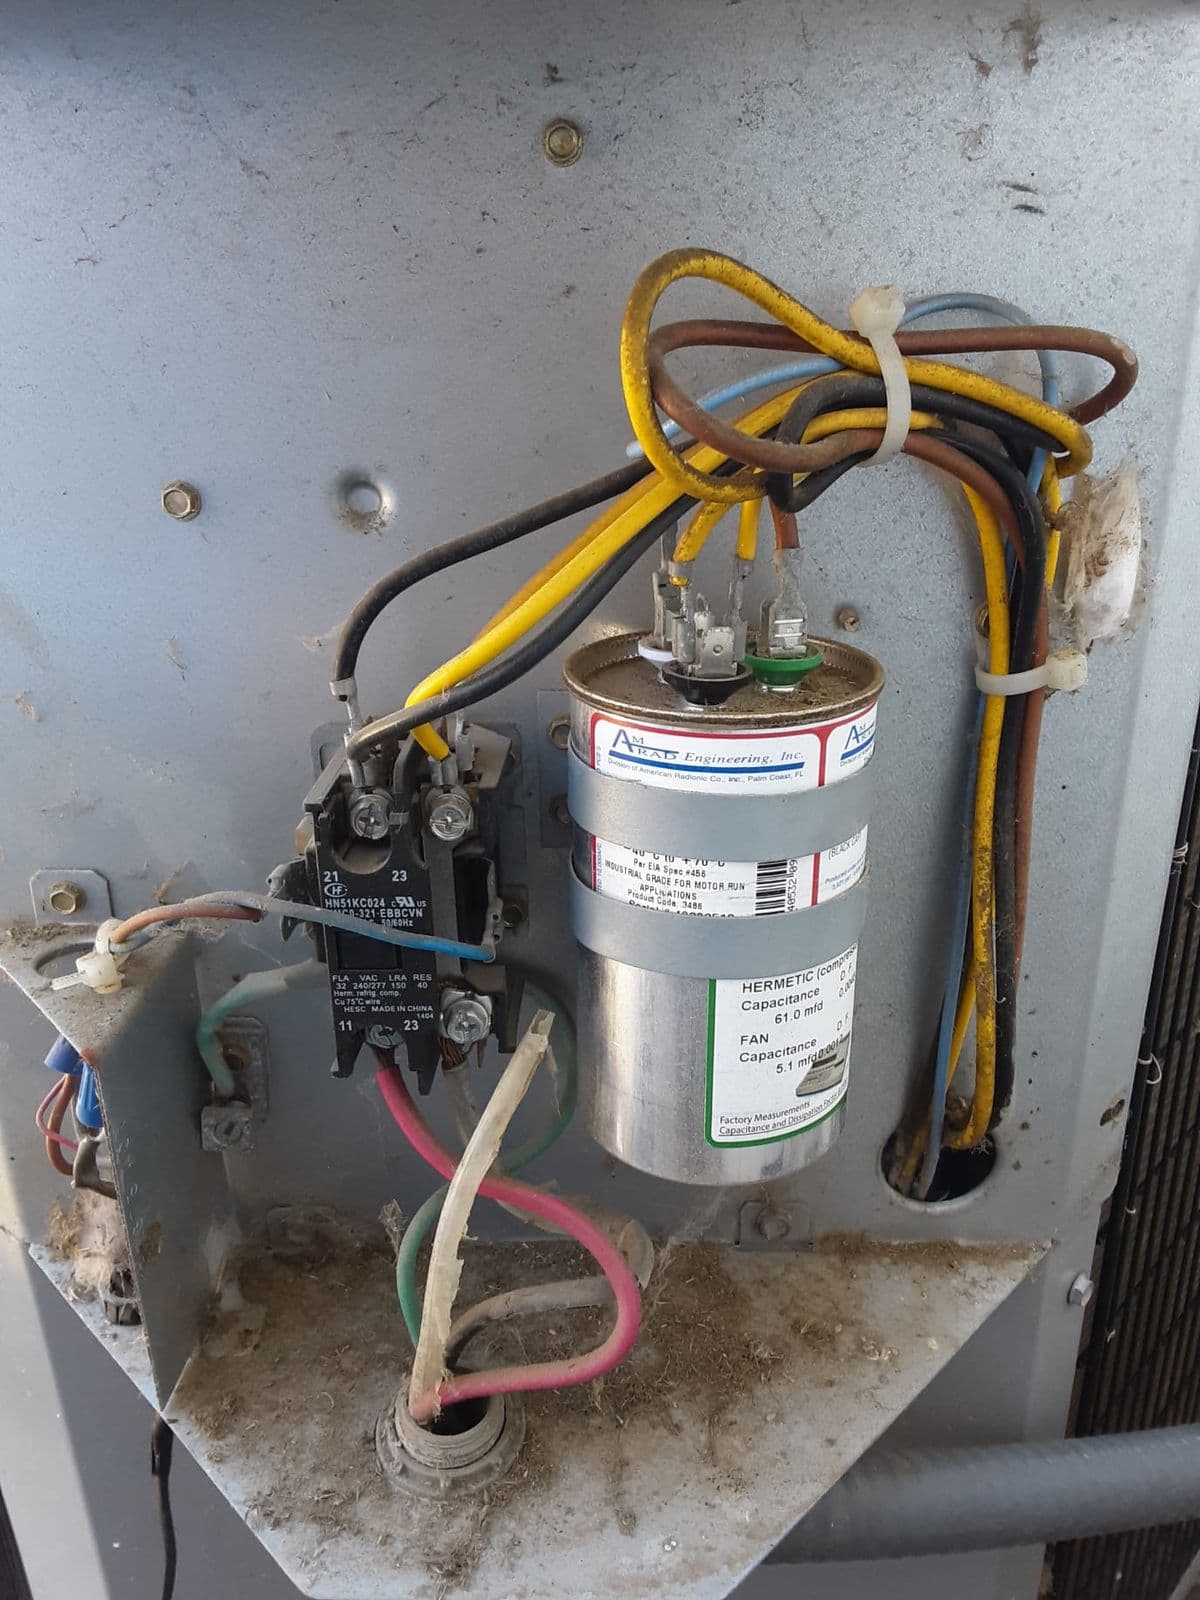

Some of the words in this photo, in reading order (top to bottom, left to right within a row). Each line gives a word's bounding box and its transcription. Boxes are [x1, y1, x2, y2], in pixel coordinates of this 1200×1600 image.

[781, 751, 804, 761] Inc.
[639, 767, 673, 778] American
[675, 773, 708, 782] Radionic
[748, 775, 768, 783] Palm
[605, 859, 643, 880] INDUSTRIAL
[646, 873, 671, 886] GRADE
[674, 878, 691, 889] FOR
[695, 881, 725, 891] MOTOR
[728, 882, 745, 891] RUN
[634, 858, 646, 868] Per
[649, 861, 661, 872] EIA
[664, 865, 683, 876] Spec
[323, 870, 339, 883] 21
[391, 869, 408, 882] 23
[628, 889, 655, 903] Product
[640, 883, 697, 901] APPLICATIONS
[325, 897, 385, 908] HN51KC024
[332, 974, 350, 982] FLA
[360, 974, 378, 982] VAC
[388, 974, 408, 982] LRA
[413, 973, 433, 981] RES
[335, 982, 347, 990] 32
[352, 982, 386, 990] 240/277
[417, 981, 428, 989] 40
[742, 970, 814, 994] HERMETIC
[741, 987, 820, 1012] Capacitance
[371, 1005, 396, 1013] MADE
[774, 1009, 800, 1025] 61.0
[804, 1001, 824, 1018] mfd
[338, 1020, 353, 1032] 11
[403, 1019, 419, 1031] 23
[740, 1033, 769, 1046] FAN
[739, 1037, 817, 1064] Capacitance
[776, 1063, 793, 1075] 5.1
[798, 1052, 817, 1068] mfd
[719, 1122, 770, 1136] Capacitance
[771, 1118, 787, 1129] and
[788, 1103, 823, 1125] Dissipation
[720, 1115, 753, 1124] Factory
[754, 1101, 810, 1121] Measurements
